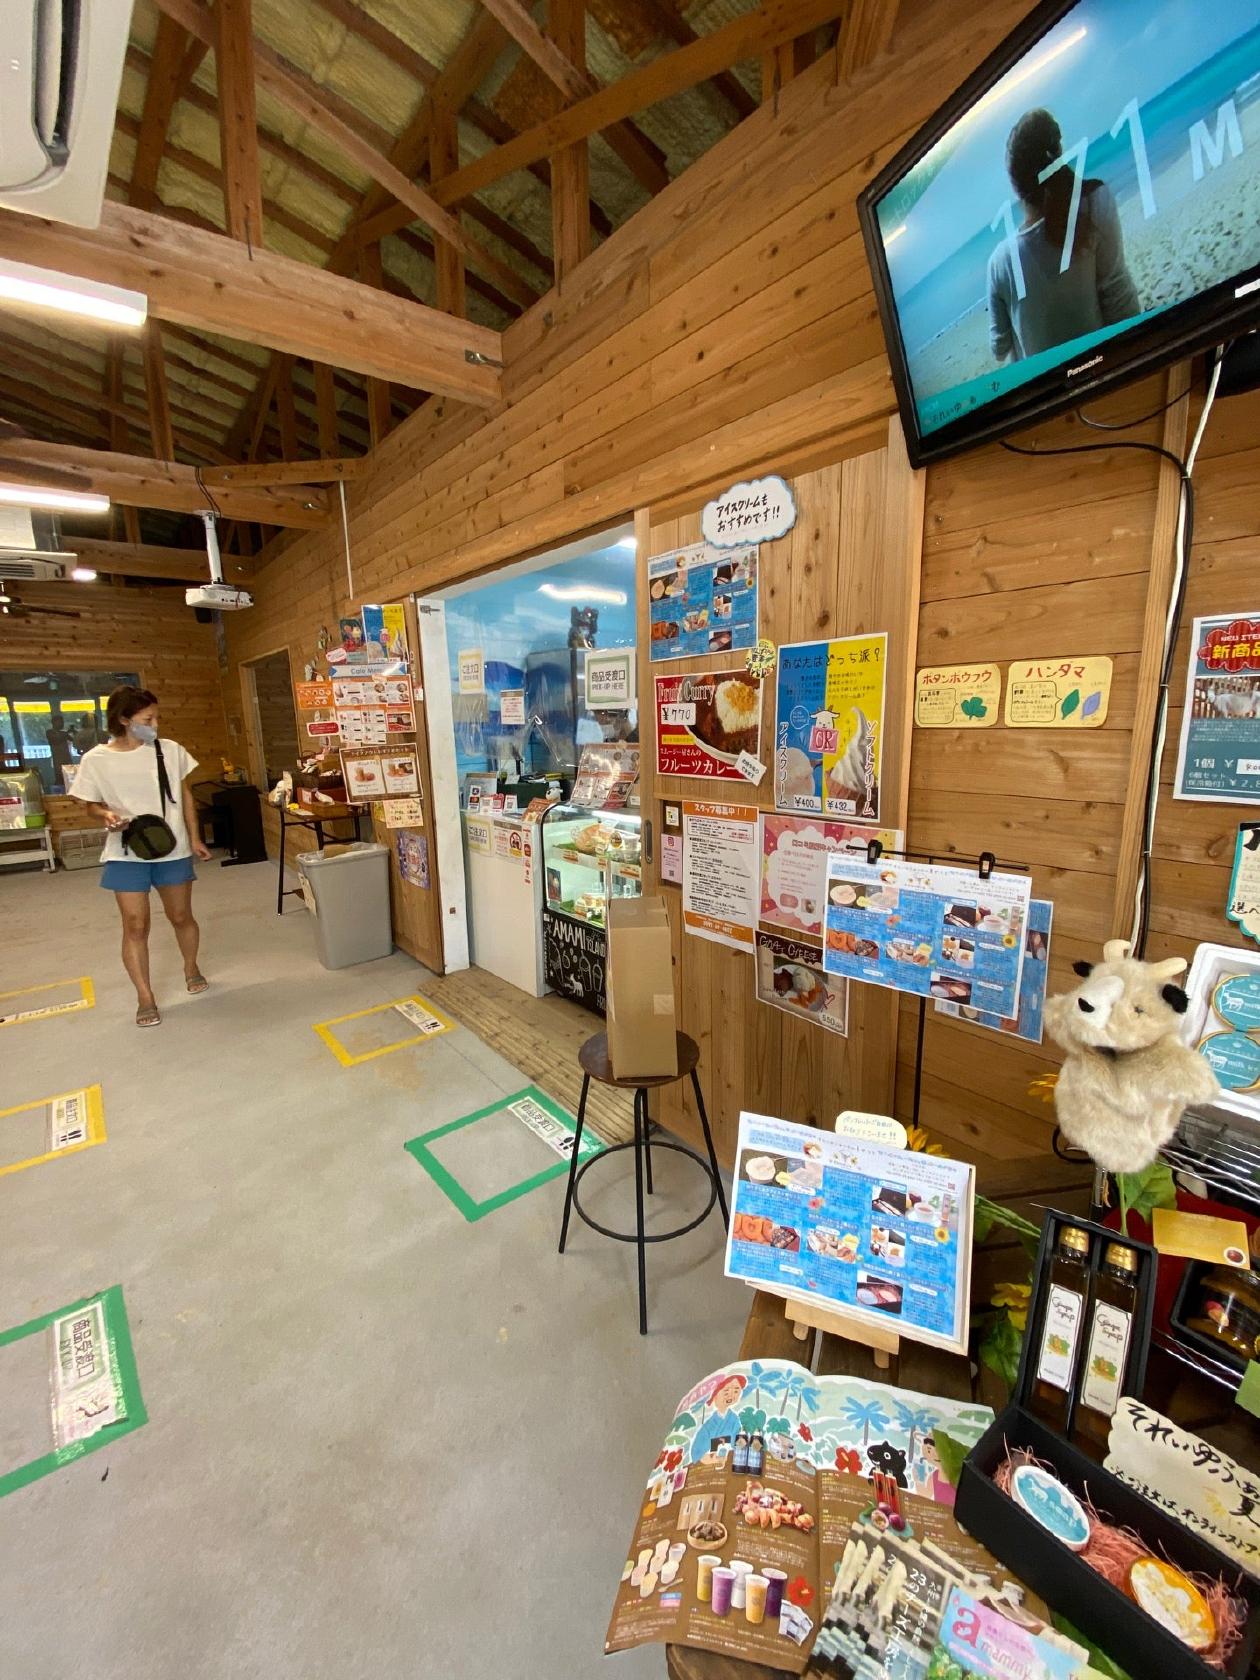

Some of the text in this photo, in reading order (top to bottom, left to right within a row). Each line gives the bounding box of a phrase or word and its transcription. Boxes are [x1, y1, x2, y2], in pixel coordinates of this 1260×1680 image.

[1067, 355, 1104, 378] Panasonic
[716, 493, 768, 519] アイスクリームも
[1241, 632, 1260, 642] ITE
[591, 669, 626, 683] 商品受渡口
[684, 680, 715, 706] Curry
[662, 707, 691, 721] ¥770
[815, 730, 835, 751] OR
[661, 758, 737, 775] フルーツカレー
[779, 721, 789, 806] アイスクリーム
[863, 720, 879, 817] ソフトクリーム
[552, 919, 586, 951] AMAMI
[73, 1318, 95, 1379] 商品受渡口
